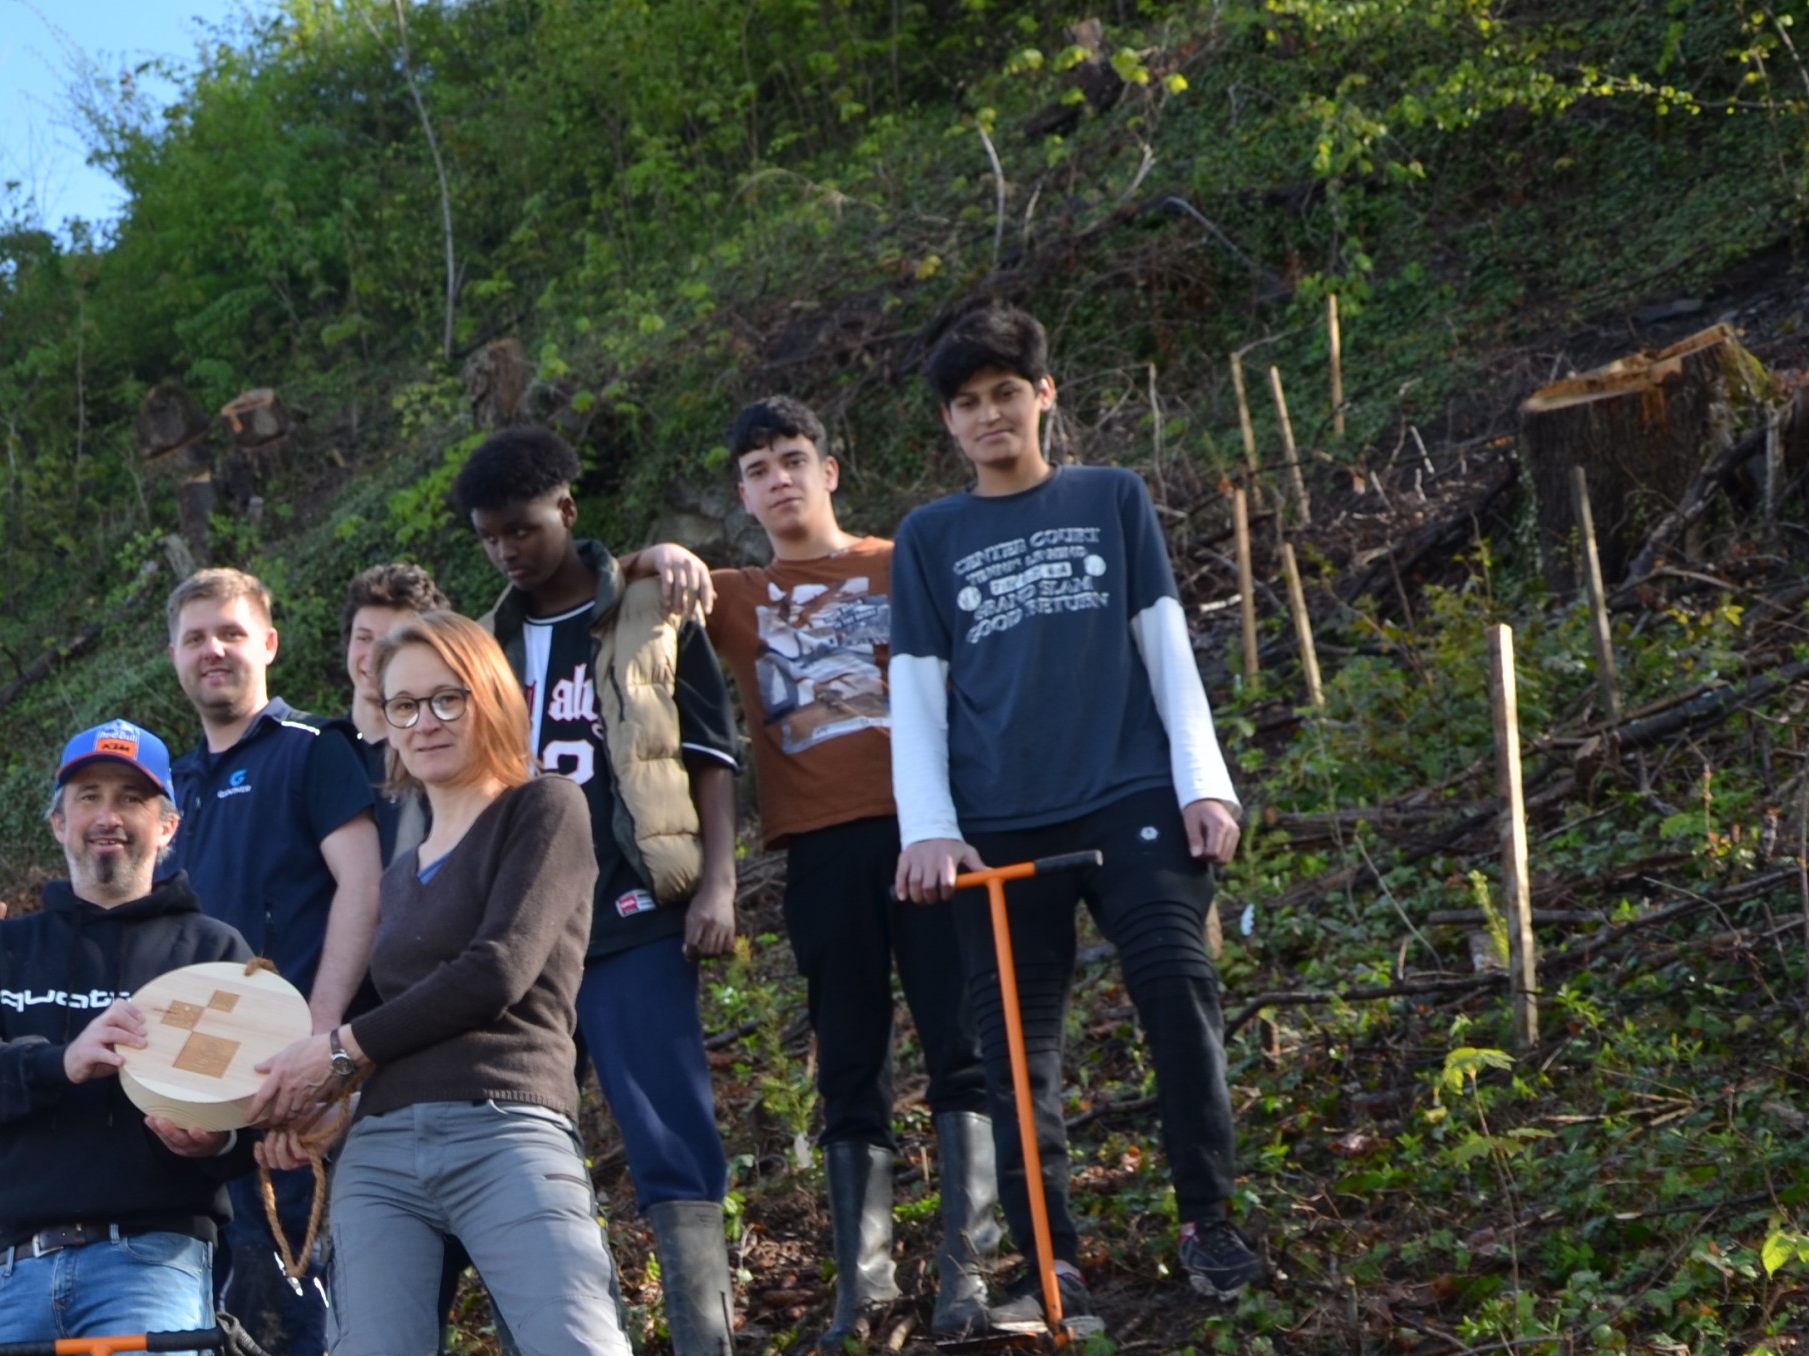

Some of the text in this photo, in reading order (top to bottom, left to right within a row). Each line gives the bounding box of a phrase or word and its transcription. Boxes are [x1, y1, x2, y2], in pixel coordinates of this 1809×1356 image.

[954, 538, 1027, 575] CENTER
[1030, 527, 1101, 548] COURT
[1039, 575, 1095, 596] SLAM
[965, 591, 1110, 644] GOOD RETURN
